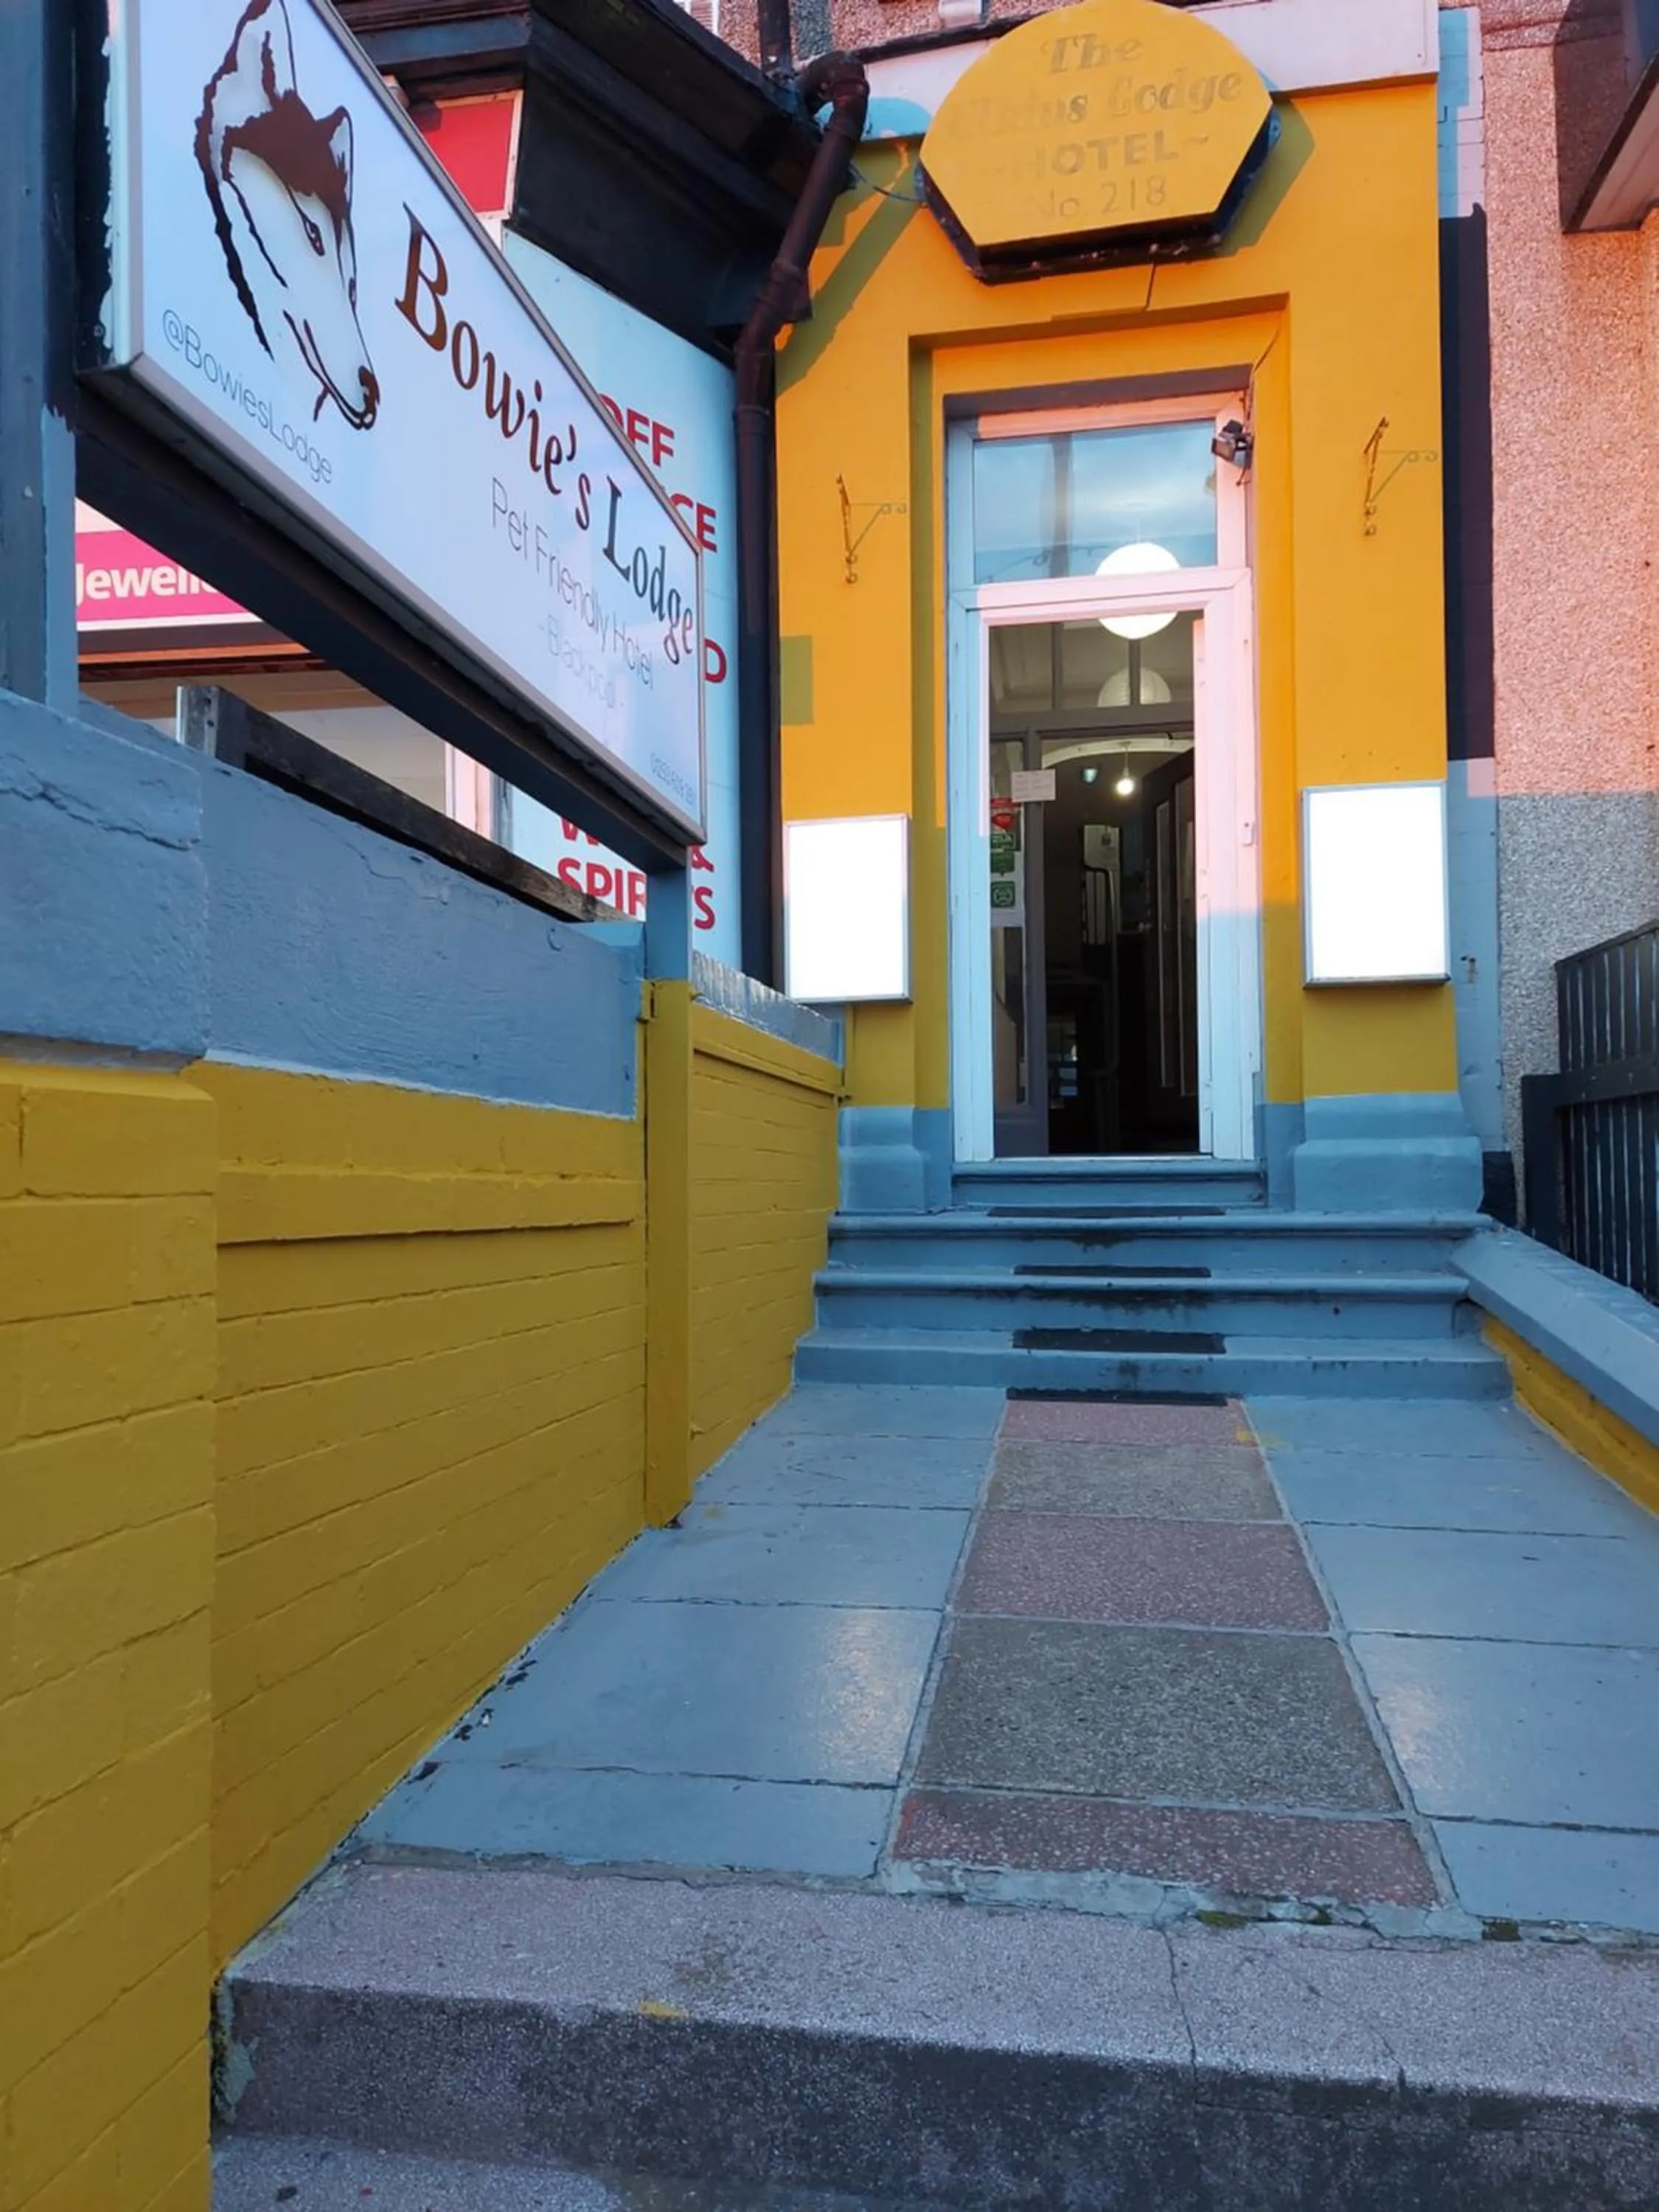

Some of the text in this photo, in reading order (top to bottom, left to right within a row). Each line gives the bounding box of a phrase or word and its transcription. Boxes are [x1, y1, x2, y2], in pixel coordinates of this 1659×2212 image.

[1040, 33, 1144, 74] The
[1100, 175, 1168, 215] 218
[161, 308, 333, 485] @BowiesLodge
[394, 201, 694, 665] Bowie's Lodge
[492, 476, 529, 561] Pet
[535, 524, 610, 654] Friendly
